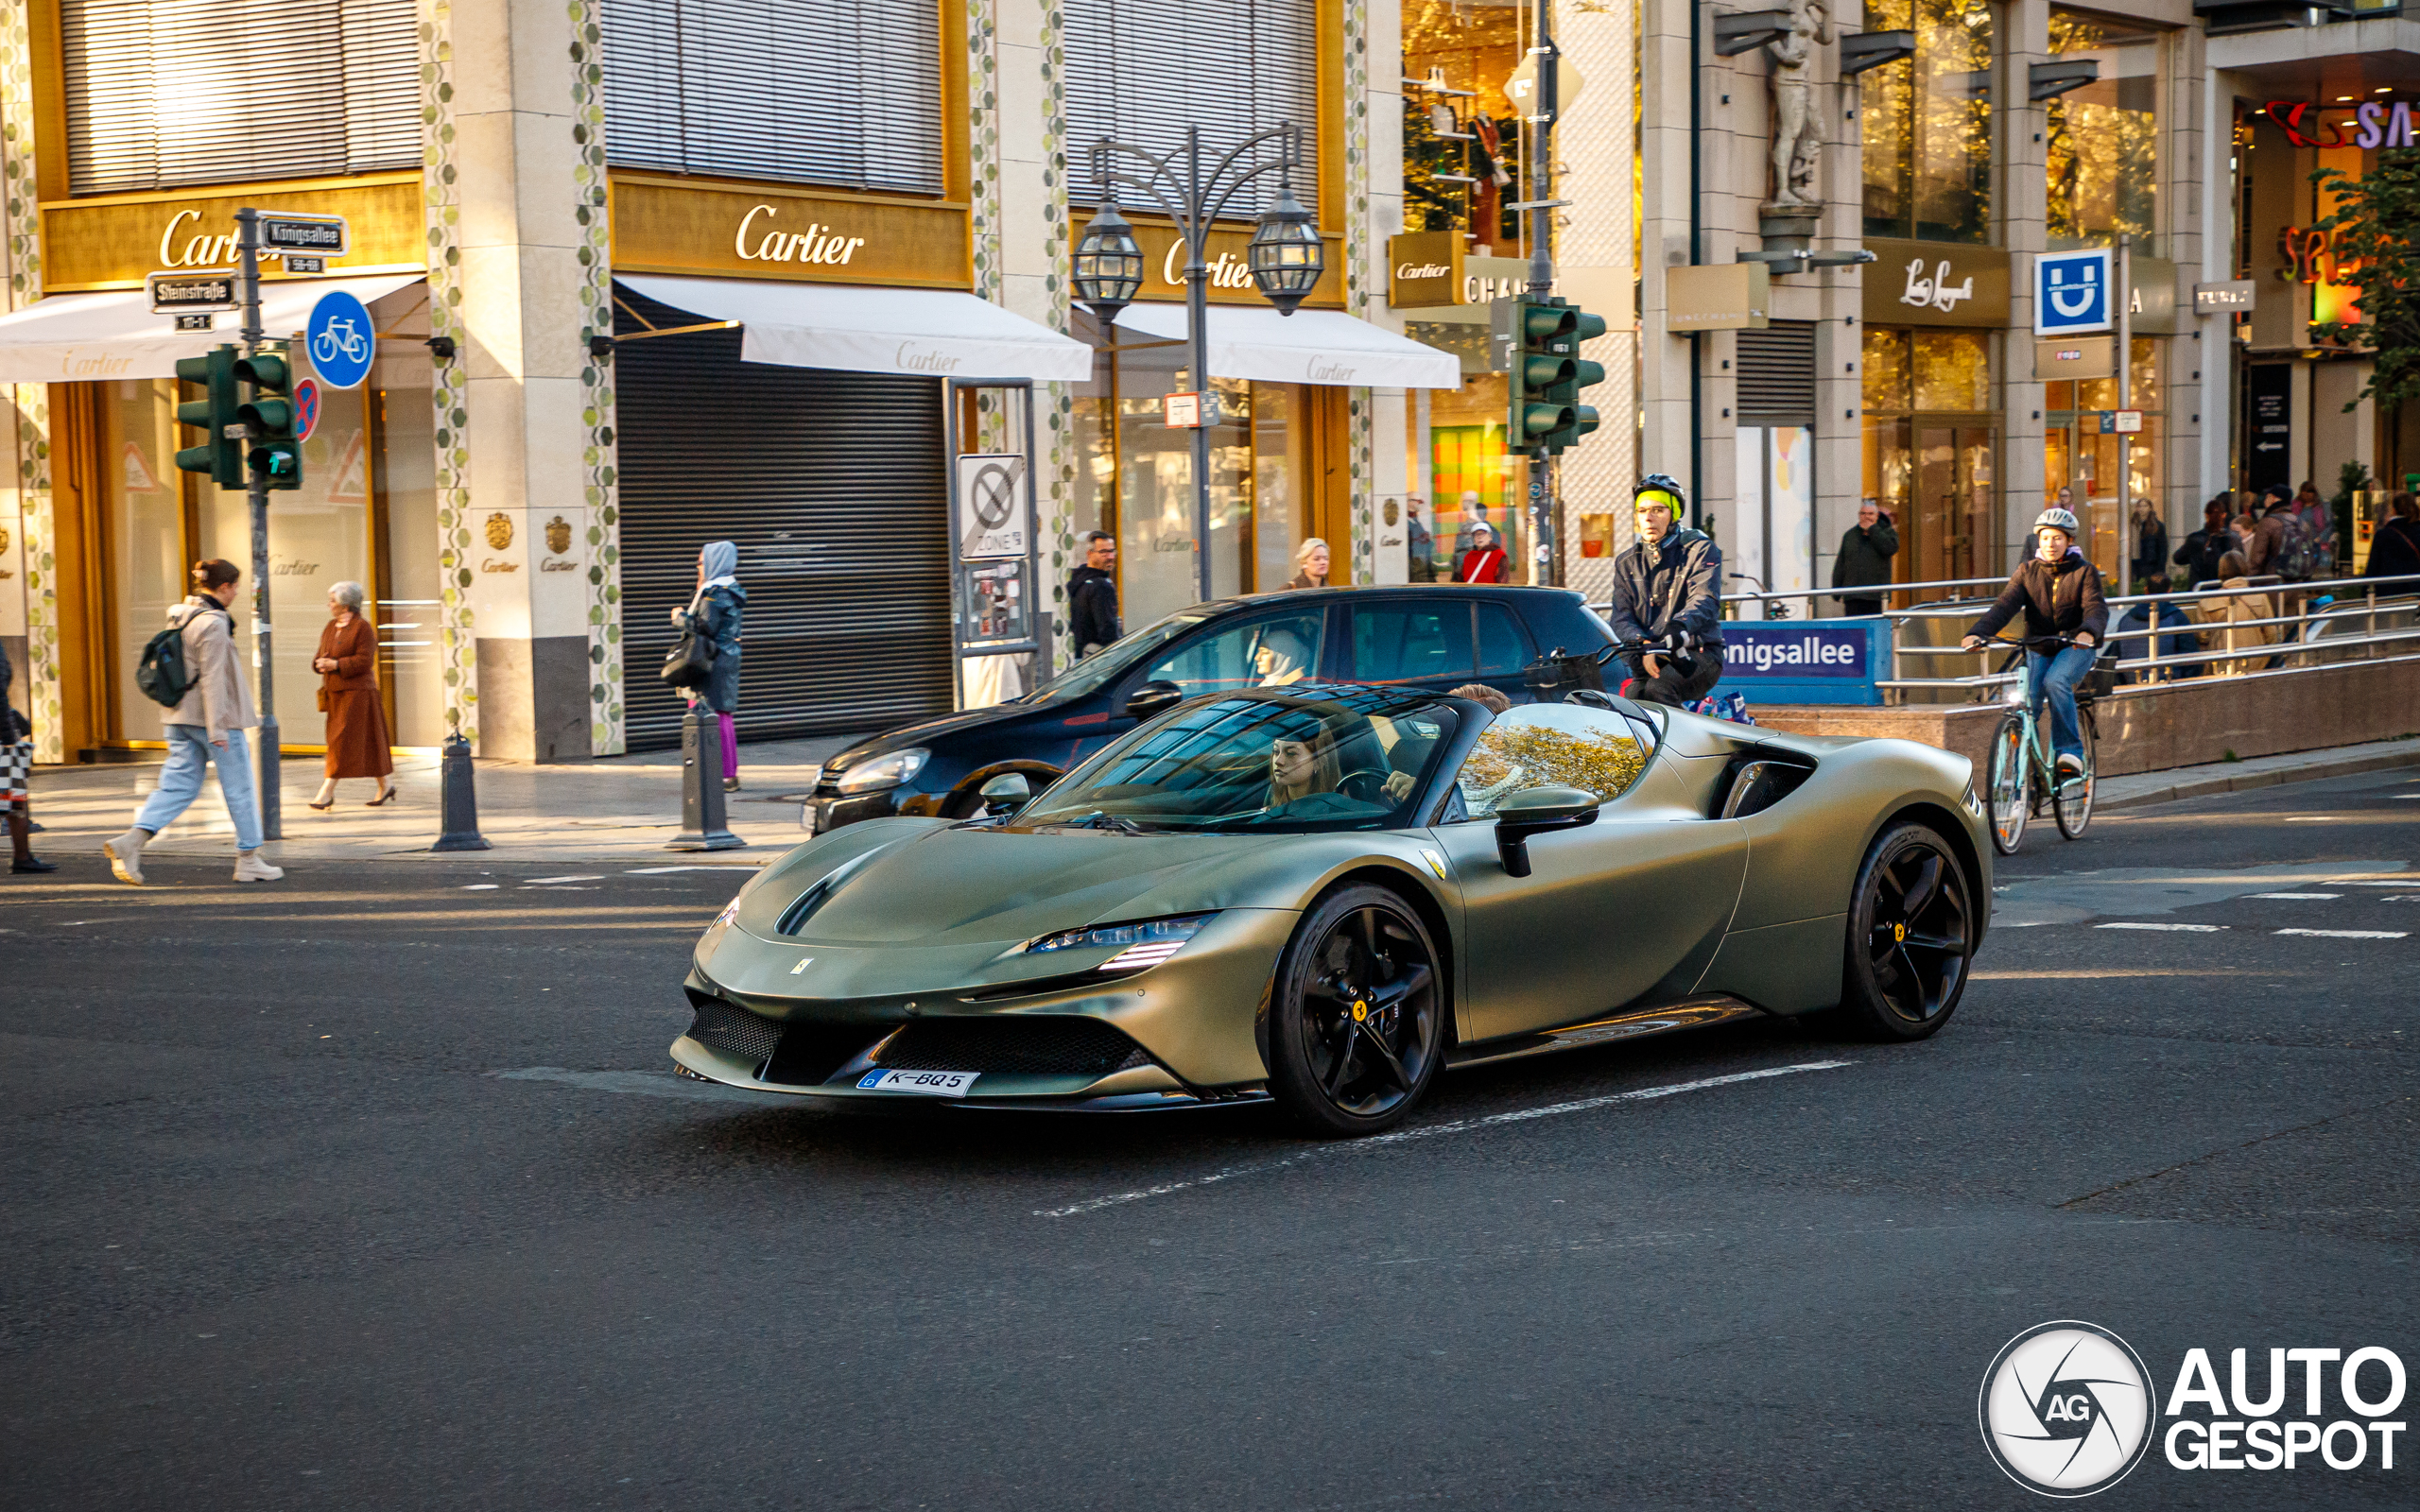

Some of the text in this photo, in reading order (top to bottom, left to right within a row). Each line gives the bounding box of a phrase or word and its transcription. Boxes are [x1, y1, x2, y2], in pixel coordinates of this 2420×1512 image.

[270, 223, 338, 246] Königsallee
[735, 204, 865, 266] Cartier
[1396, 262, 1451, 281] Cartier
[157, 281, 227, 301] Steinstraße
[62, 345, 134, 376] Cartier
[894, 339, 962, 371] Cartier
[1306, 353, 1357, 381] Cartier
[481, 558, 519, 574] Cartier
[540, 558, 579, 573] Cartier
[1723, 636, 1856, 672] nigsallee
